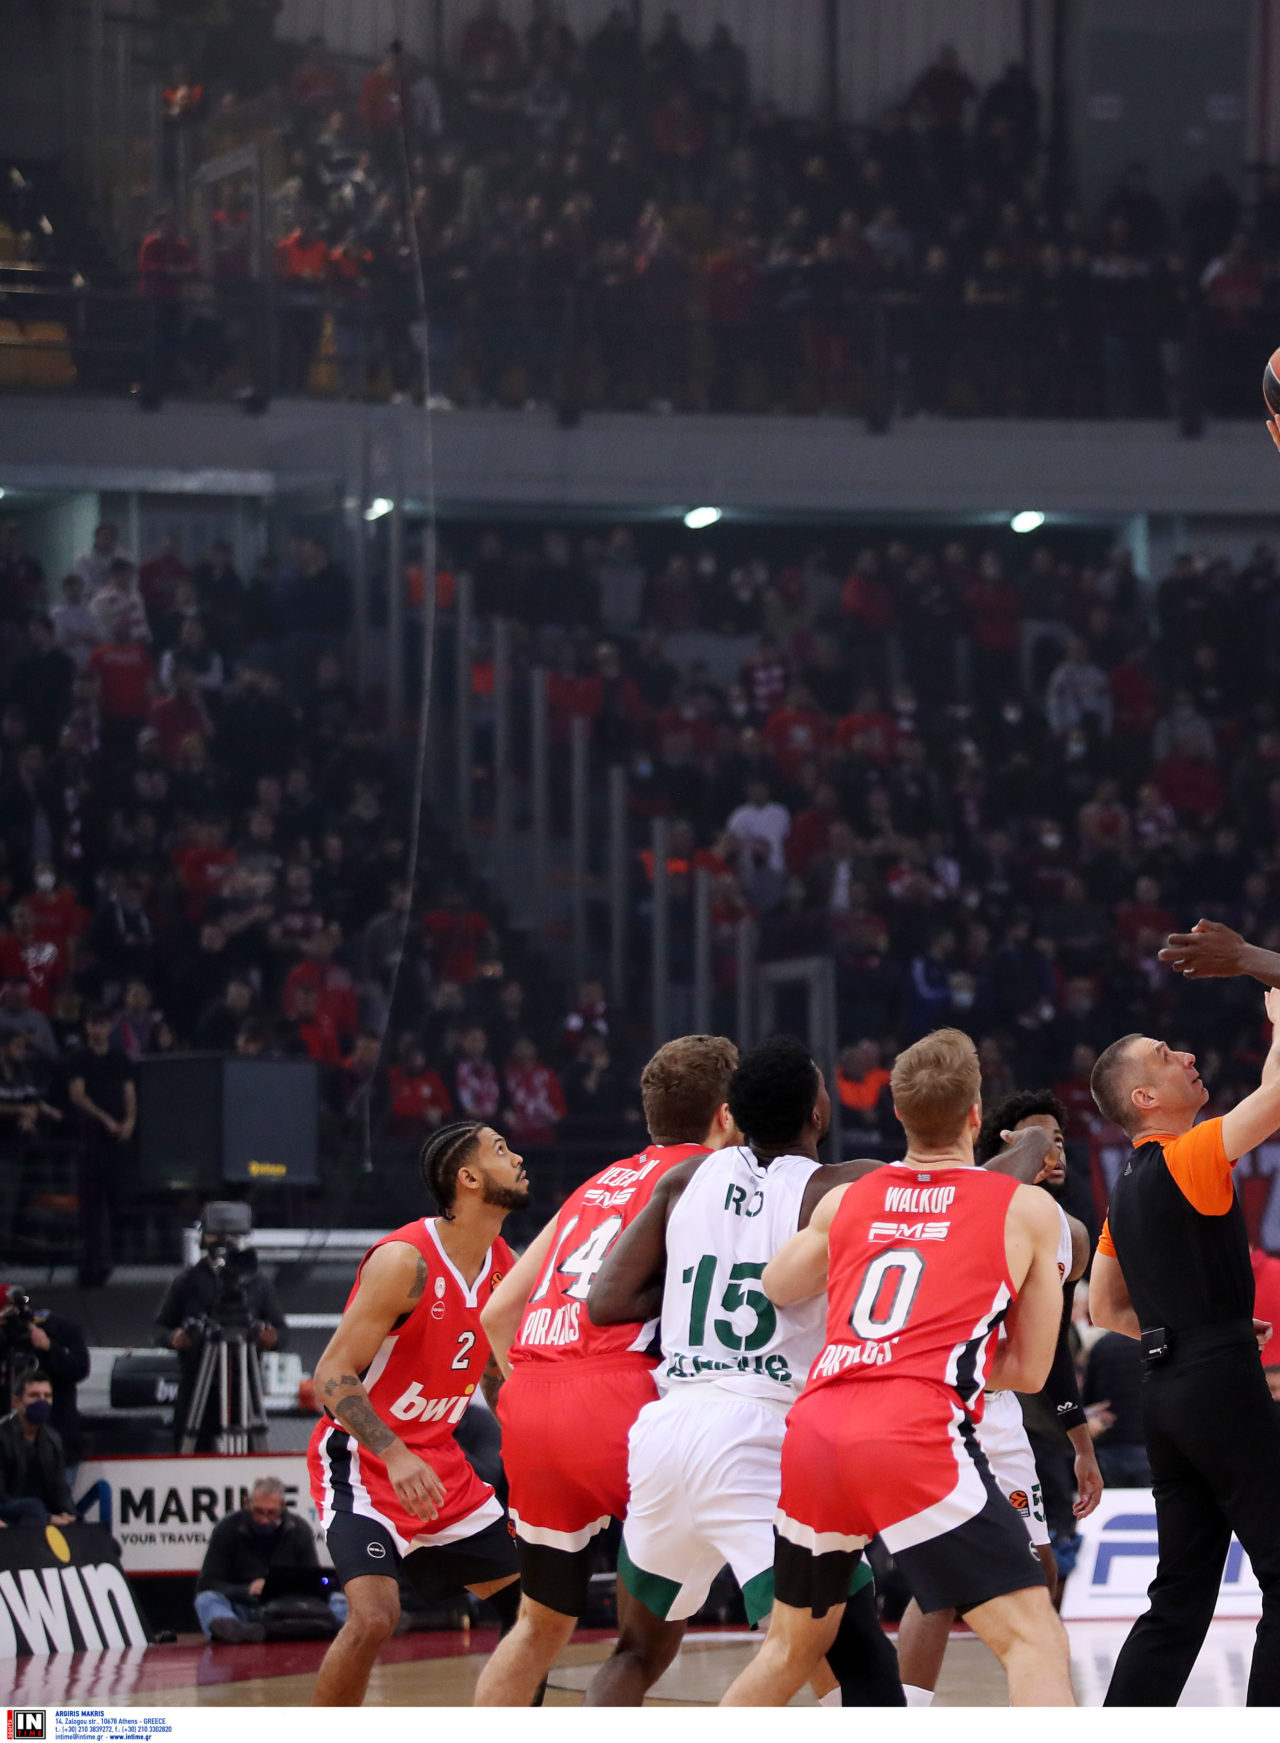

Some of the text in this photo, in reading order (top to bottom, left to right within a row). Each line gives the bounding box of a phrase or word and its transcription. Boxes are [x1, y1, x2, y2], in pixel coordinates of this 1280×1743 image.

[884, 1186, 956, 1214] WALKUP
[868, 1221, 951, 1243] FMS
[528, 1214, 625, 1304] 14
[682, 1254, 777, 1352] 15
[848, 1247, 927, 1341] 0
[450, 1330, 476, 1371] 2
[389, 1380, 476, 1424] bwi
[121, 1531, 157, 1546] YOUR
